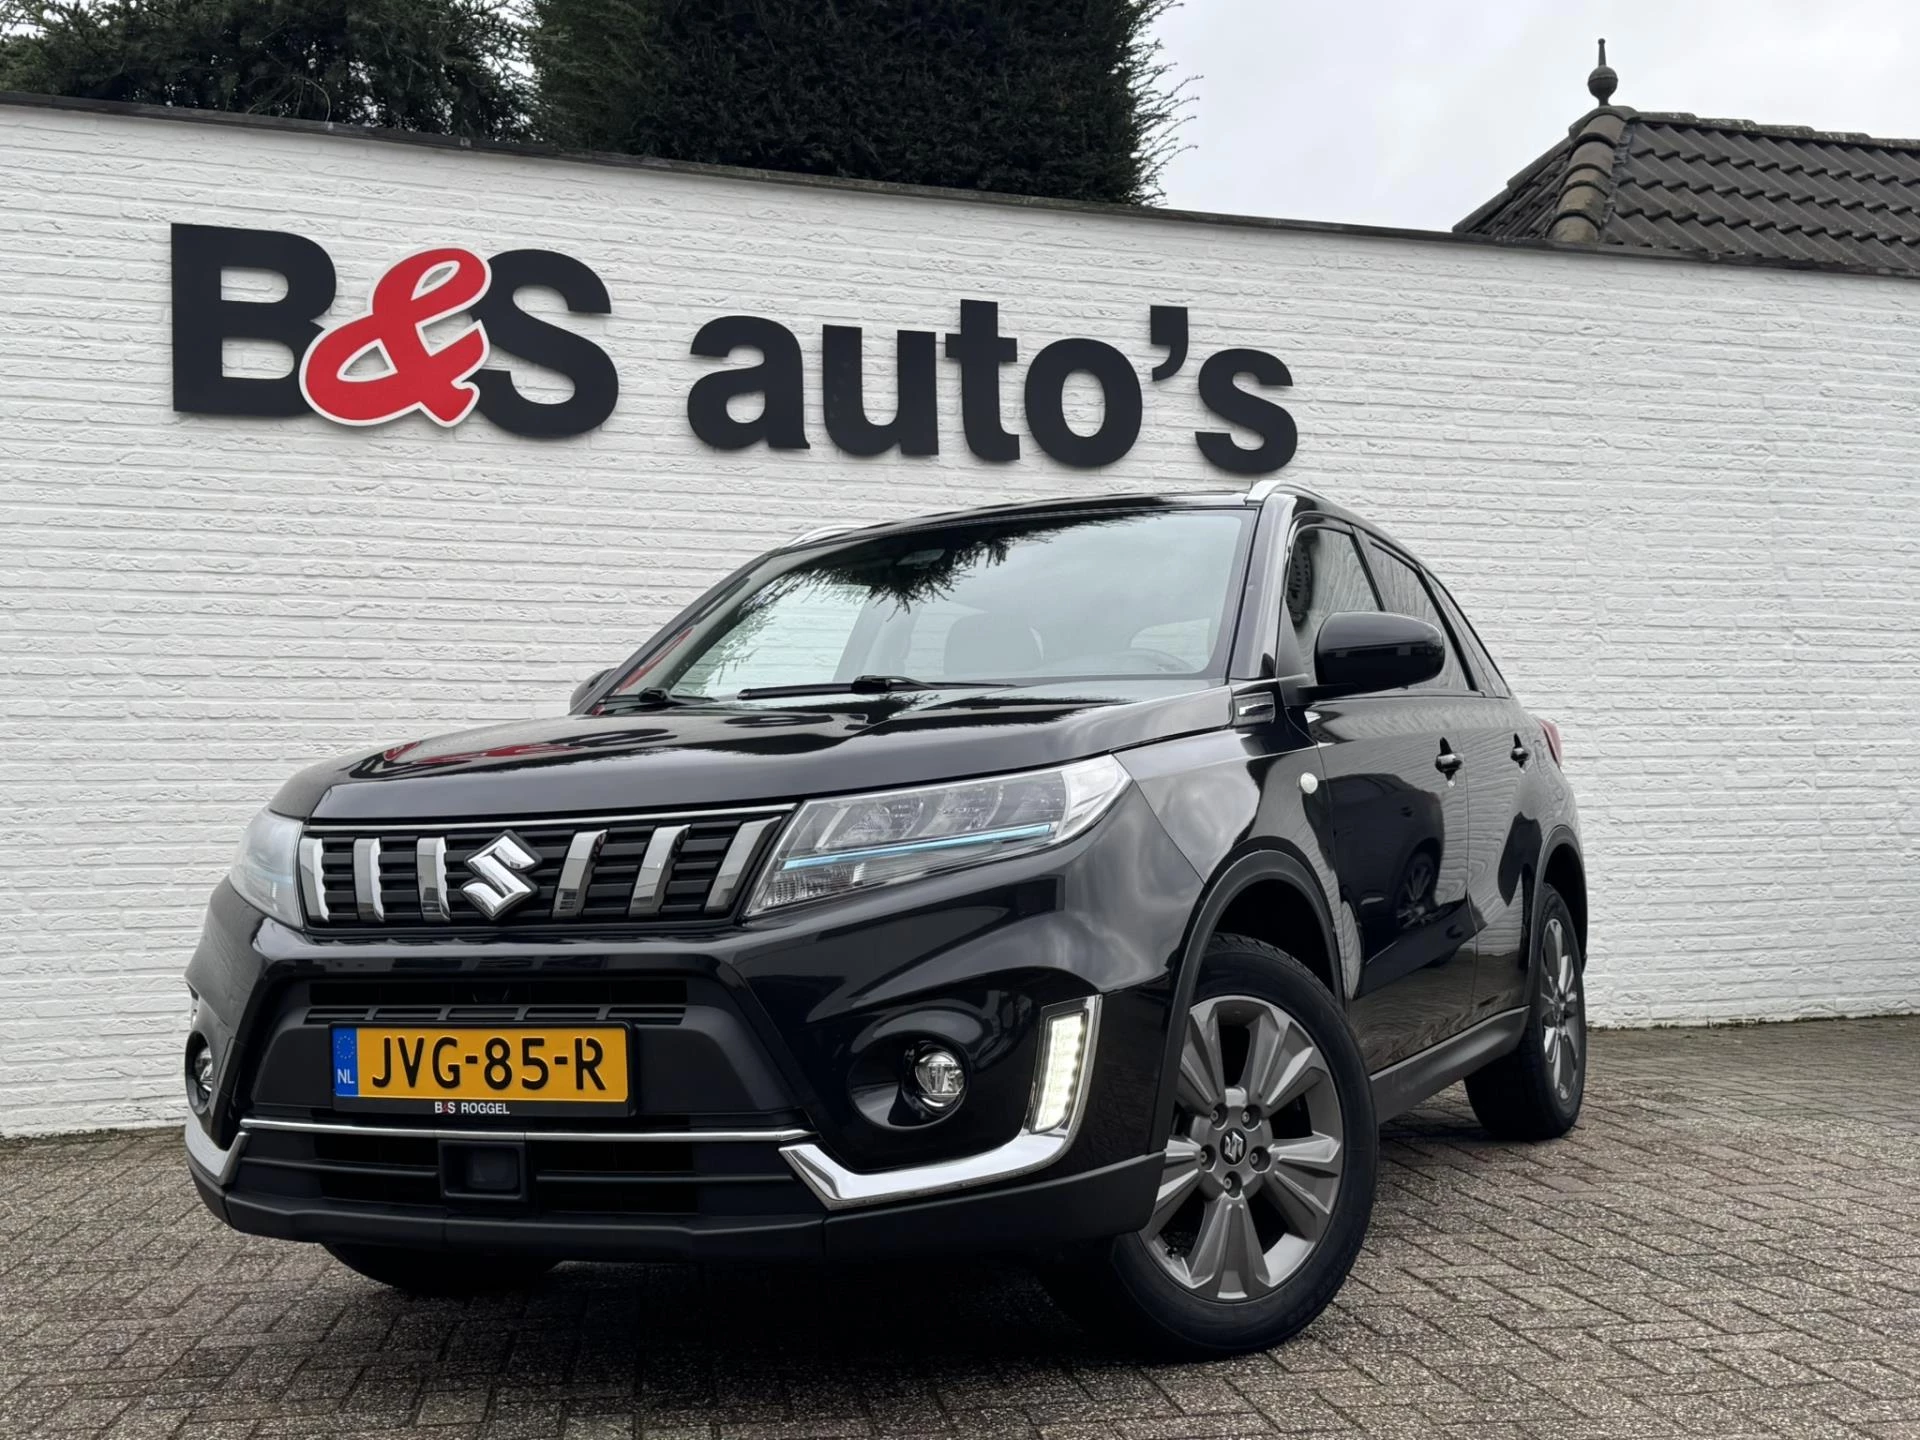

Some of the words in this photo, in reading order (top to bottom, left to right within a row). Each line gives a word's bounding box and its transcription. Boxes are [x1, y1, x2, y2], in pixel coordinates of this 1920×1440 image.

[171, 223, 619, 438] B&S
[687, 299, 1299, 474] auto's
[337, 1068, 355, 1085] NL
[372, 1037, 606, 1091] JVG-85-R
[460, 1102, 510, 1115] ROGGEL
